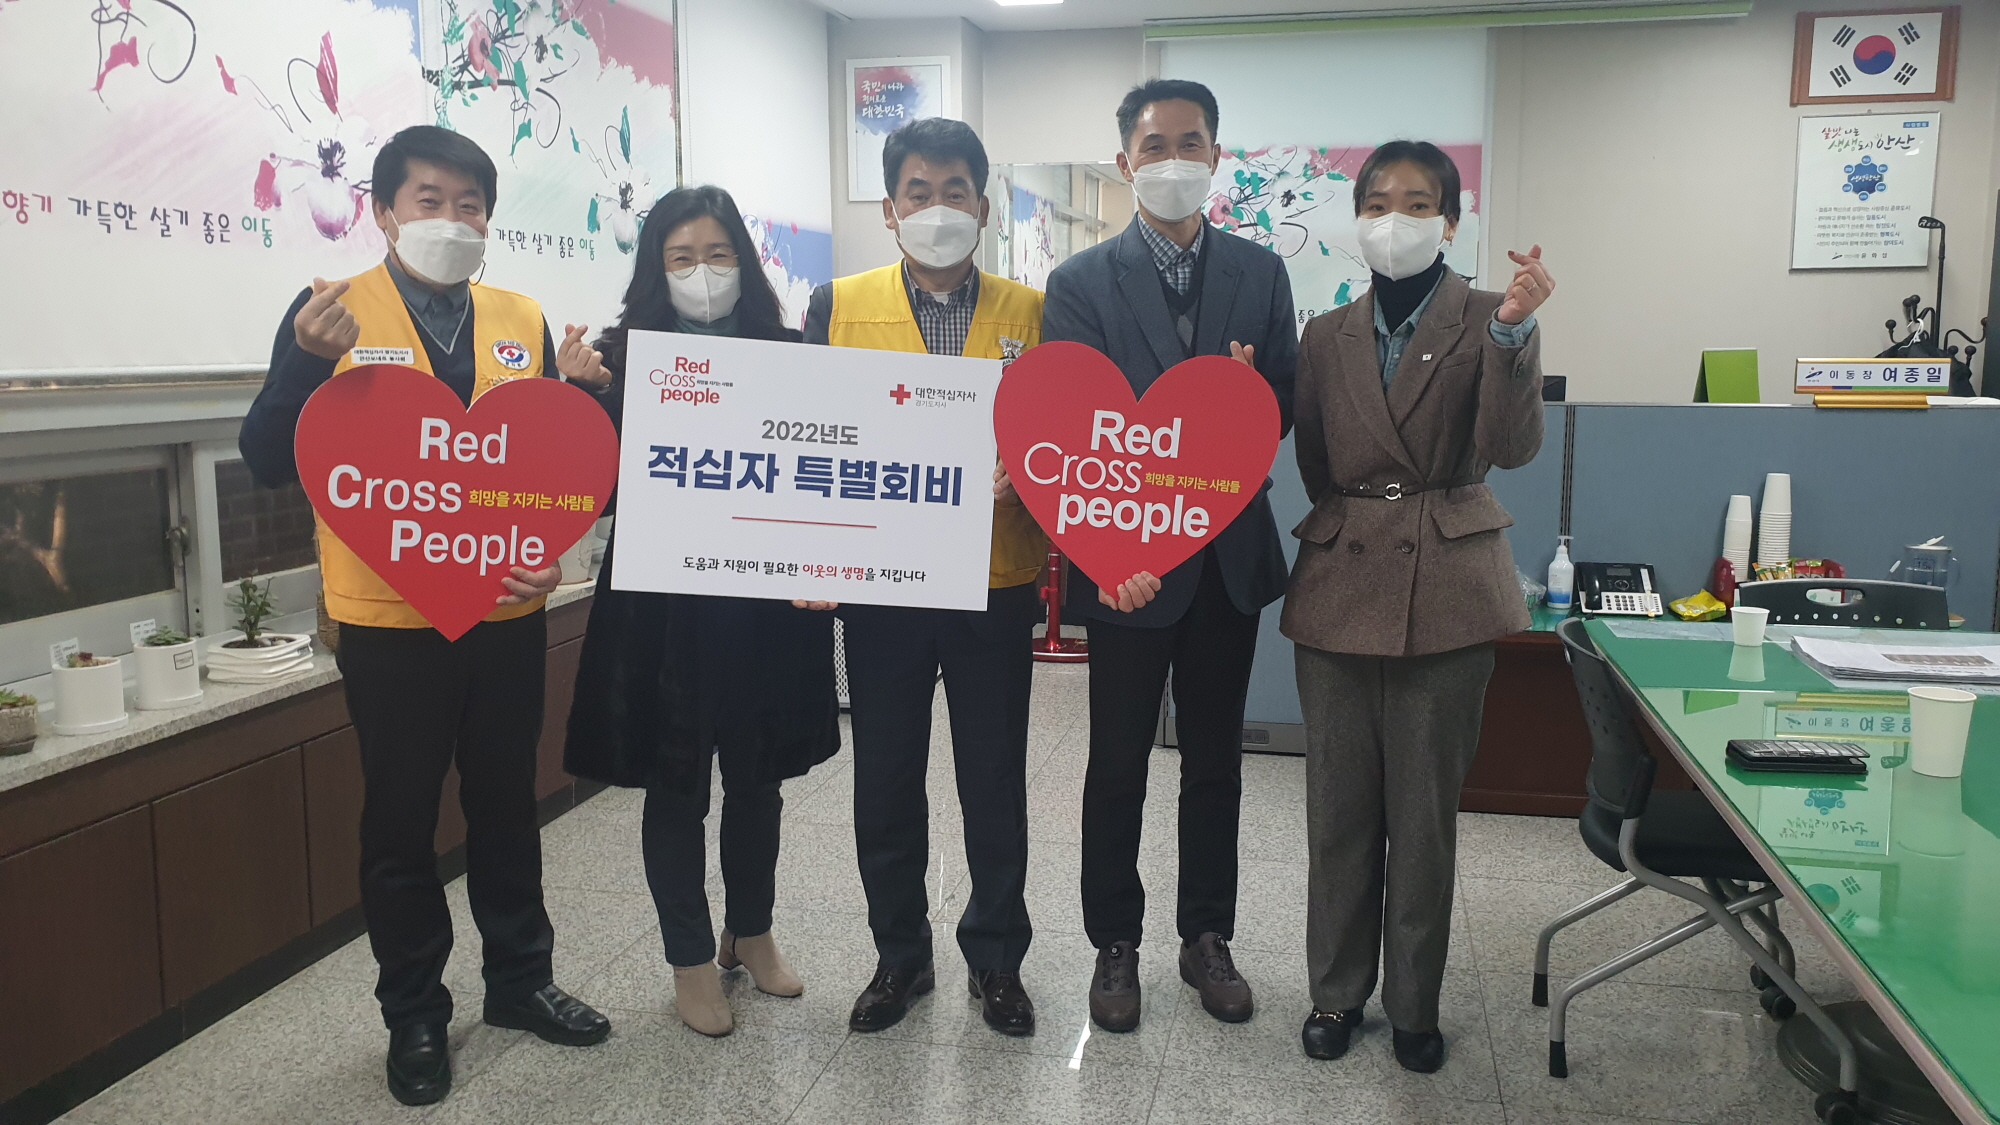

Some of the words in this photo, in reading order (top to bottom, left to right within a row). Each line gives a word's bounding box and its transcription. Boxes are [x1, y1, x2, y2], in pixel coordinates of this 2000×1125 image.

[861, 80, 886, 93] 국민의
[887, 82, 905, 92] 나라
[862, 103, 905, 119] 대한민국
[1876, 134, 1915, 150] 안산
[2, 189, 52, 224] 향기
[68, 197, 138, 234] 가득한
[150, 206, 189, 238] 살기
[203, 211, 231, 244] 좋은
[241, 215, 273, 248] 이동
[495, 228, 527, 252] 가득한
[532, 233, 552, 254] 살기
[559, 235, 574, 258] 좋은
[579, 238, 595, 261] 이동
[675, 356, 710, 374] Red
[1882, 367, 1942, 383] 여종일
[649, 368, 696, 388] Cross
[660, 387, 720, 406] people
[915, 387, 977, 402] 대한적십자사
[915, 400, 947, 408] 경기도지사
[419, 416, 508, 464] Red
[761, 419, 859, 446] 2022년도
[1090, 409, 1182, 459] Red
[647, 444, 780, 494] 적십자
[793, 454, 963, 506] 특별회비
[1024, 441, 1143, 493] Cross
[327, 464, 462, 514] Cross
[1144, 472, 1175, 488] 희망을
[1176, 475, 1208, 491] 지키는
[1209, 479, 1241, 494] 사람들
[468, 489, 511, 508] 희망을
[512, 491, 553, 509] 지키는
[555, 494, 595, 512] 사람들
[1056, 493, 1210, 543] people
[390, 519, 545, 576] People
[682, 556, 720, 571] 도움과
[723, 558, 759, 574] 지원이
[763, 561, 799, 577] 필요한
[802, 563, 838, 579] 이웃의
[840, 565, 876, 581] 생명을
[879, 568, 927, 583] 지킵니다
